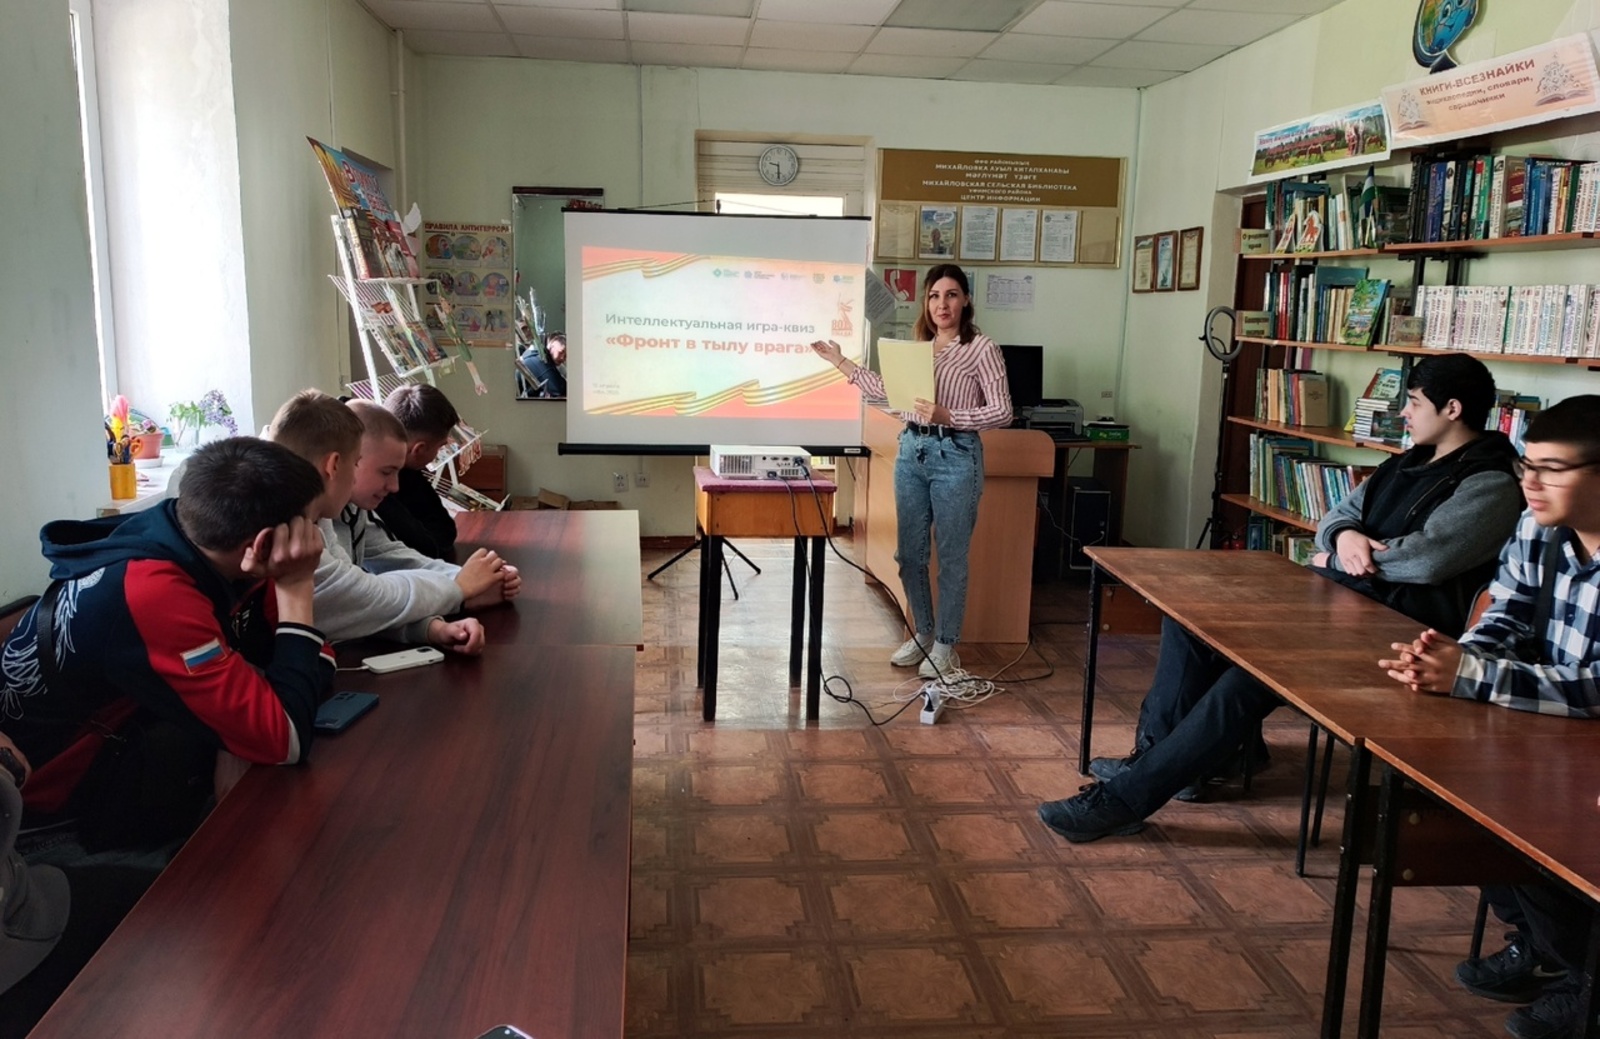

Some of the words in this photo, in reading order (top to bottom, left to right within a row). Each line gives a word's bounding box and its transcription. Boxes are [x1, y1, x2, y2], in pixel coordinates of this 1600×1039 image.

[1419, 58, 1536, 97] КНИГИ-ВСЕЗНАЙКИ
[1487, 76, 1534, 92] словари,
[1448, 92, 1506, 111] справочники
[935, 163, 989, 171] МИХАЙЛОВКА
[986, 181, 1026, 189] СЕЛЬСКАЯ
[1027, 182, 1078, 191] БИБЛИОТЕКА
[986, 195, 1041, 203] ИНФОРМАЦИИ
[425, 223, 458, 231] ПРАВИЛА
[605, 313, 742, 331] Интеллектуальная
[746, 321, 815, 334] игра-квиз
[606, 333, 680, 351] «Фронт
[686, 338, 696, 349] в
[702, 339, 748, 354] тылу
[754, 341, 814, 356] врага»
